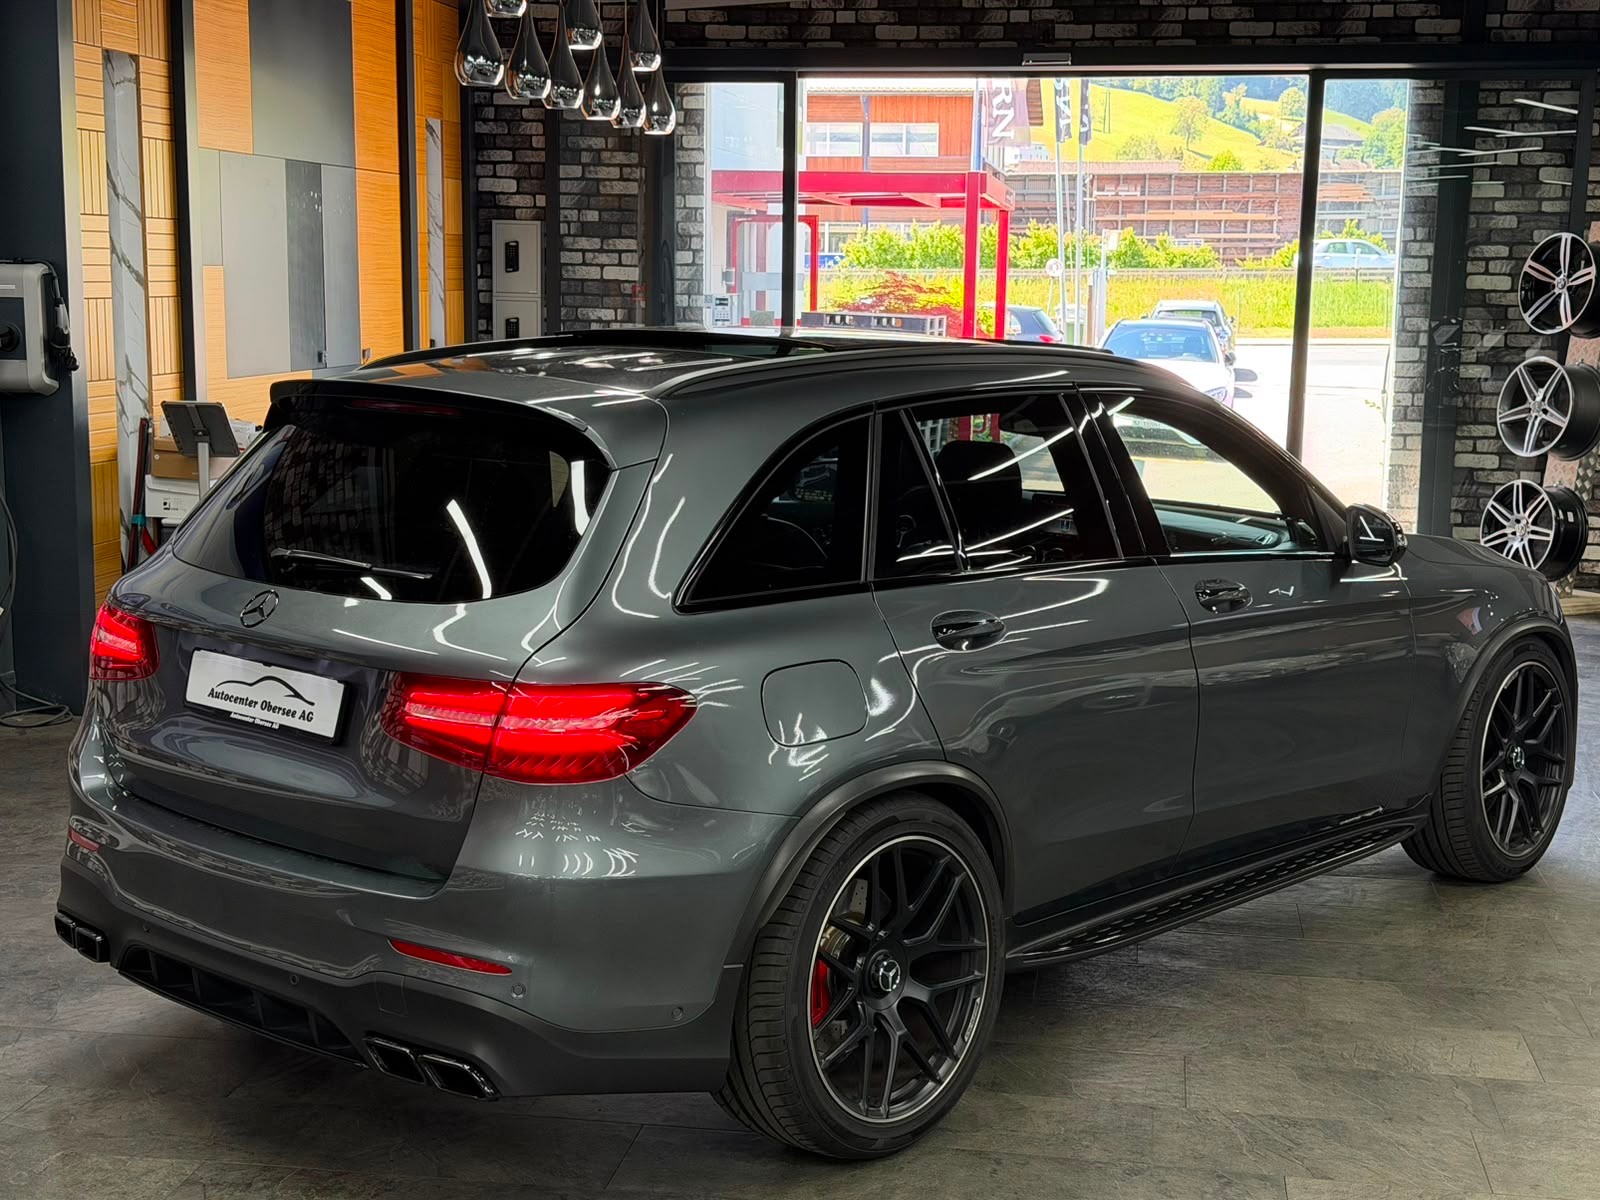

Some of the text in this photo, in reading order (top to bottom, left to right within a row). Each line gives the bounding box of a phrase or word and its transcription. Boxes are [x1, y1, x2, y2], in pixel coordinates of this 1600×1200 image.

[207, 687, 314, 722] Autocenter Obersee AG
